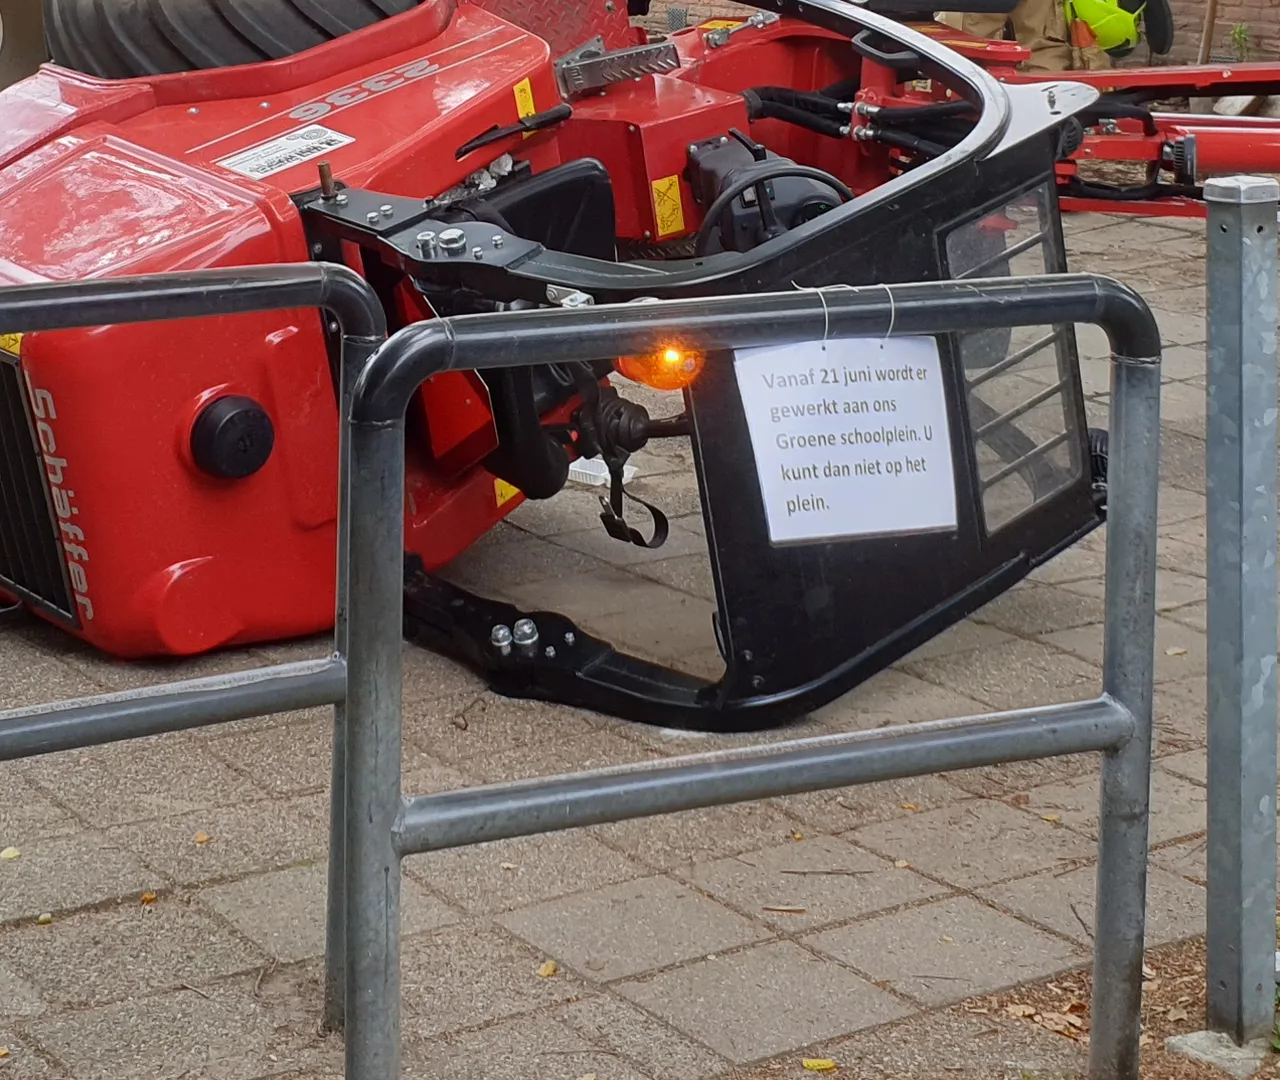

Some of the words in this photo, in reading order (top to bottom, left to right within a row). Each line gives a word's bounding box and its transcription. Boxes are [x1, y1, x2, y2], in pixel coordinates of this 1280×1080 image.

[288, 58, 440, 121] 2336
[762, 368, 815, 390] Vanaf
[820, 368, 840, 385] 21
[841, 366, 872, 387] juni
[875, 365, 915, 383] wordt
[915, 367, 928, 380] er
[770, 399, 839, 423] gewerkt
[842, 400, 869, 414] aan
[873, 397, 897, 413] ons
[775, 433, 836, 450] Groene
[840, 426, 921, 447] schoolplein.
[923, 425, 933, 441] U
[781, 463, 819, 482] kunt
[823, 461, 850, 477] dan
[854, 458, 882, 476] niet
[885, 461, 903, 476] op
[905, 455, 927, 473] het
[31, 387, 94, 620] Schäffer
[786, 494, 830, 516] plein.
